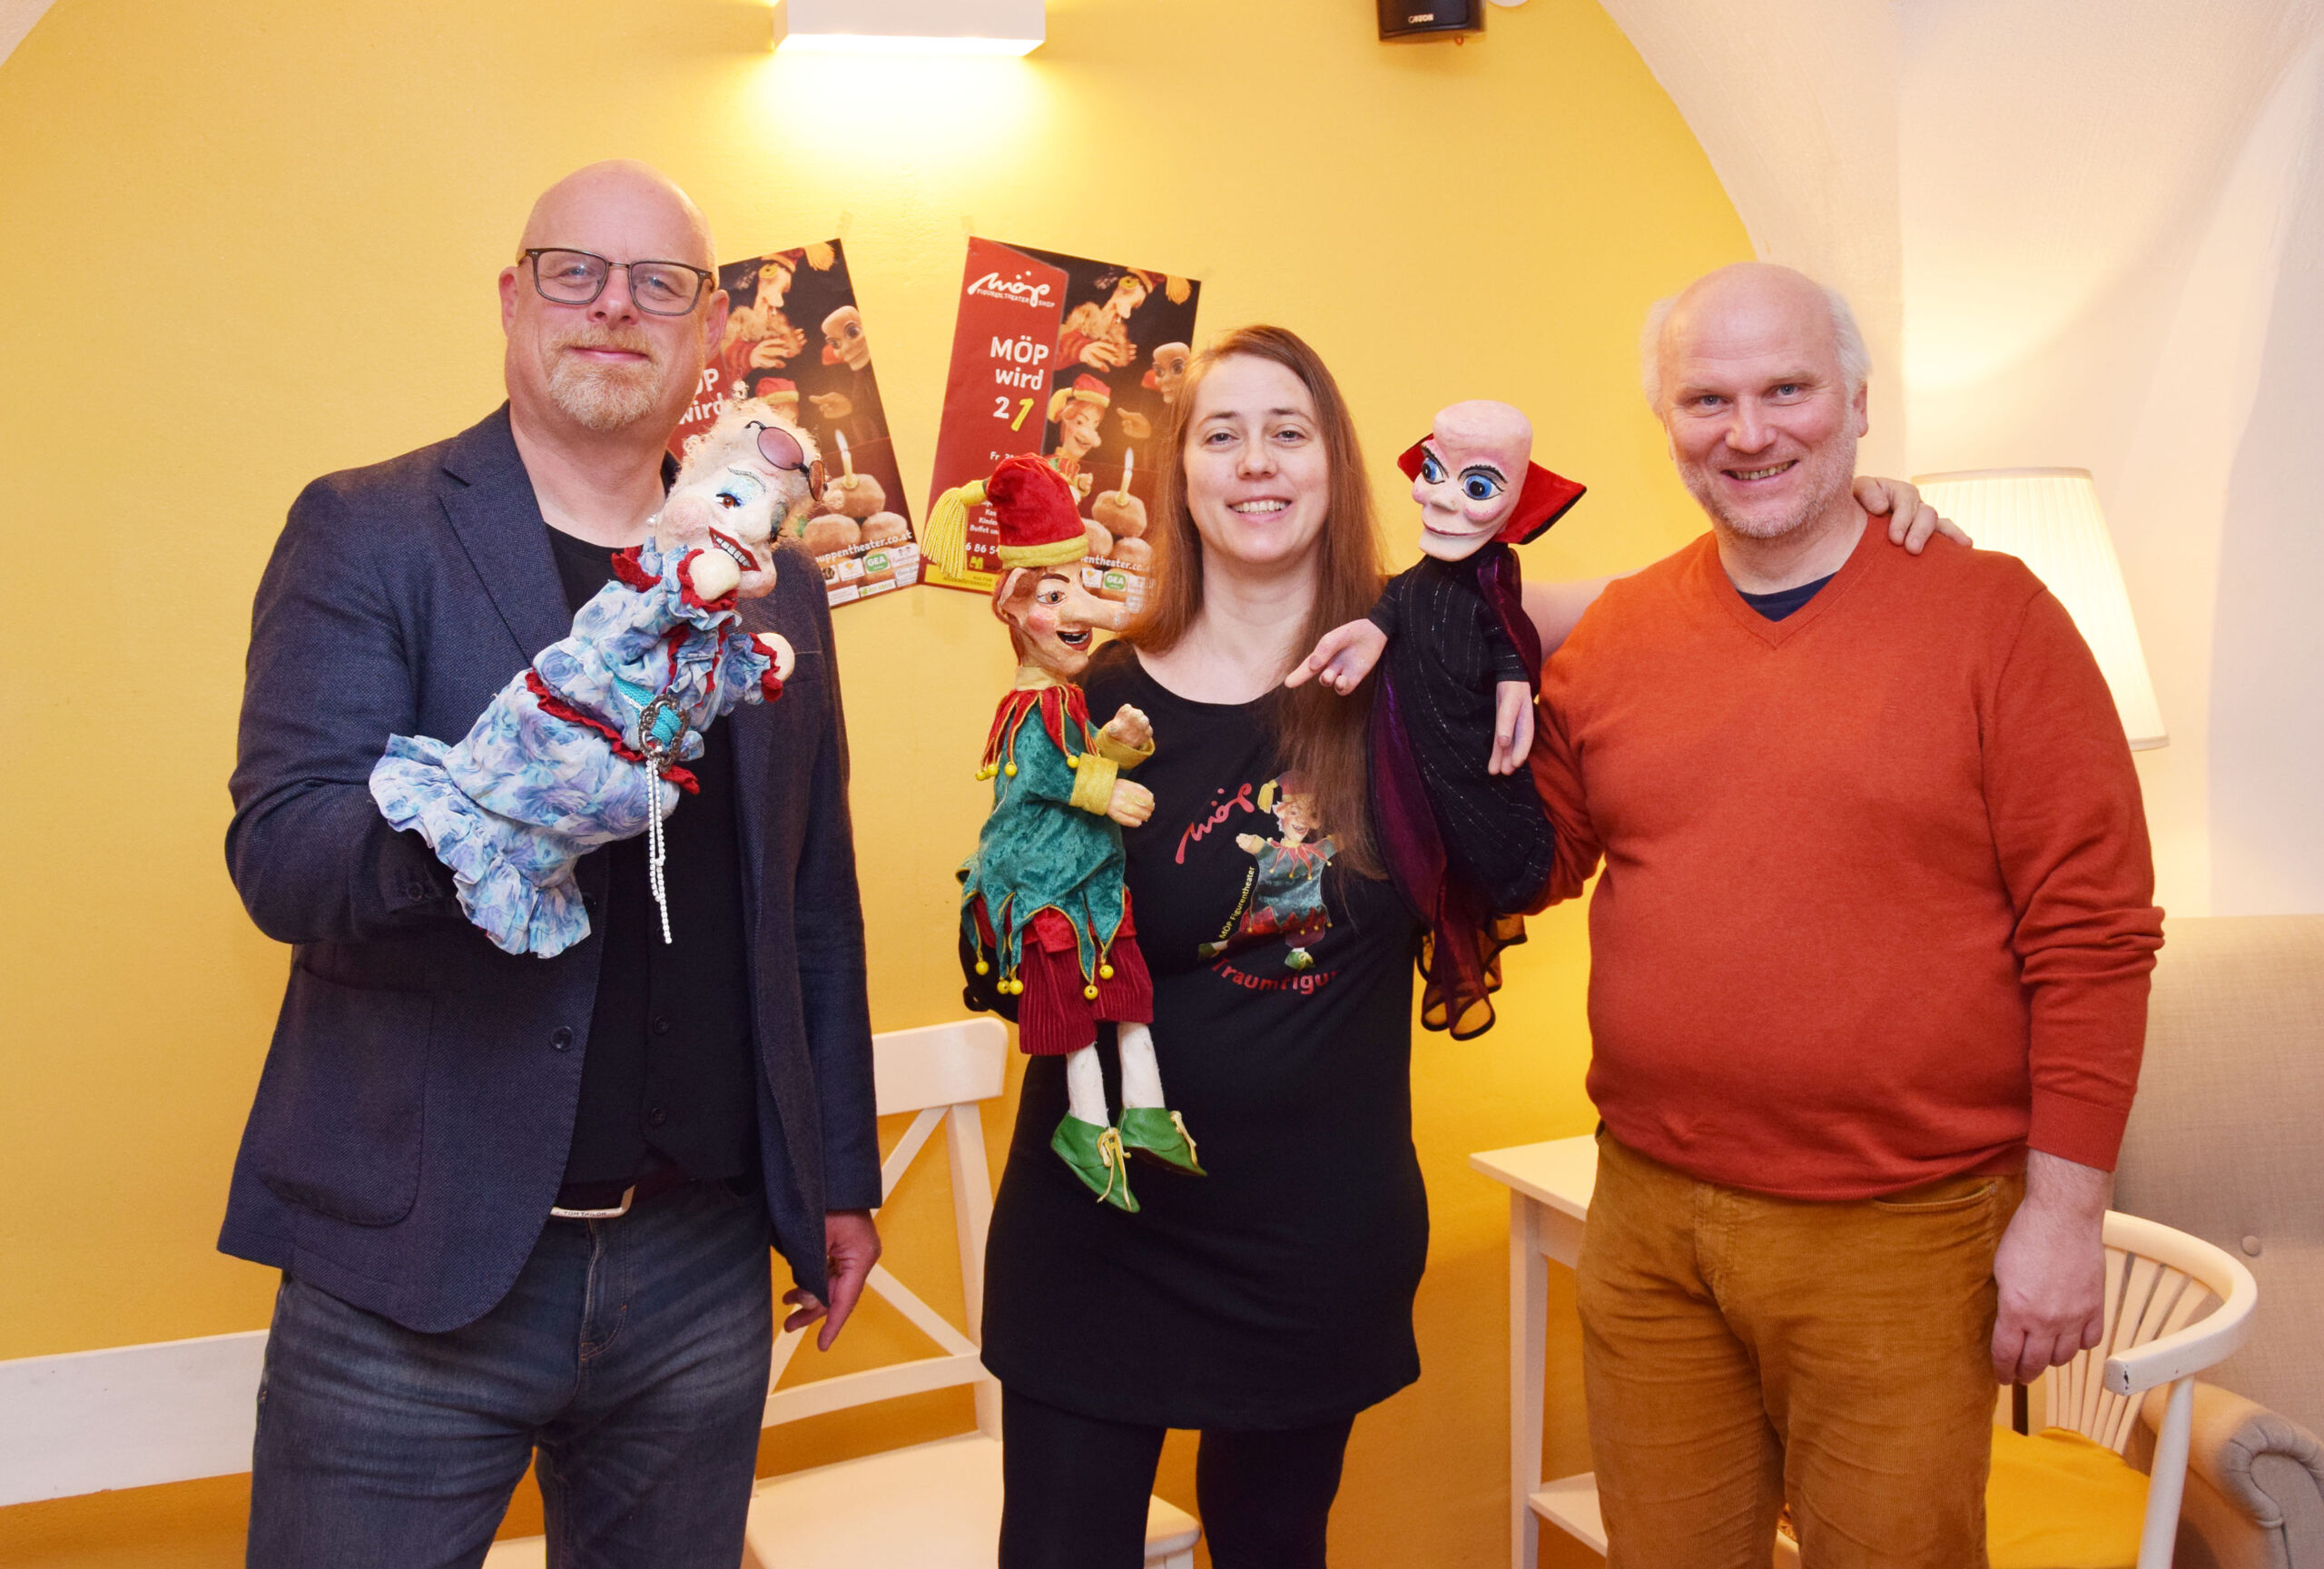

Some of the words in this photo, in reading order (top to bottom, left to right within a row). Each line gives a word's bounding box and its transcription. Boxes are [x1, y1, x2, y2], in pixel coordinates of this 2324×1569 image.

[990, 335, 1049, 366] MÖP
[995, 367, 1044, 390] wird
[970, 524, 989, 534] Buffet
[974, 543, 987, 554] 86
[867, 556, 886, 567] GEA
[1107, 575, 1124, 585] GEA
[1230, 865, 1256, 920] Figurentheater
